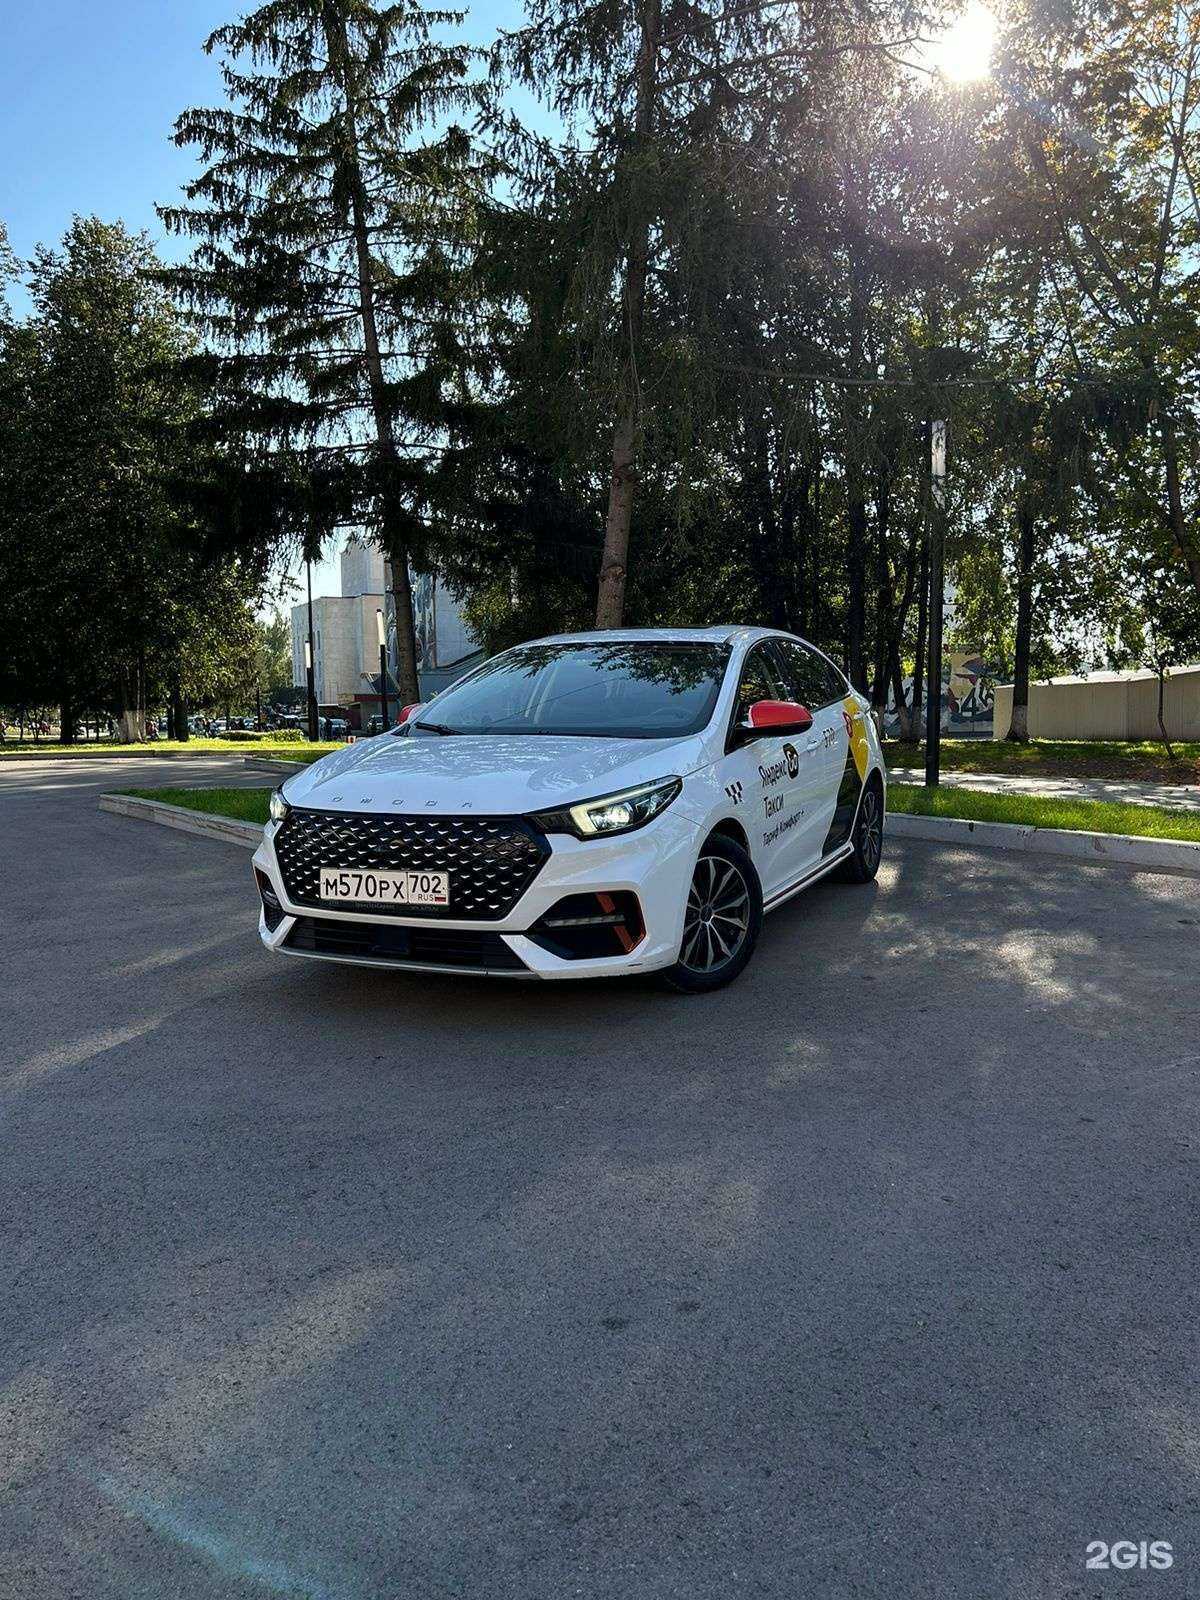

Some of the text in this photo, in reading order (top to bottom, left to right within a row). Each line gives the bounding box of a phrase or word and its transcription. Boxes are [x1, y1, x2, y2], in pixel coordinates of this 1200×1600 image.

[758, 759, 787, 787] Яндекс
[763, 793, 784, 819] Такси
[409, 875, 441, 893] 702
